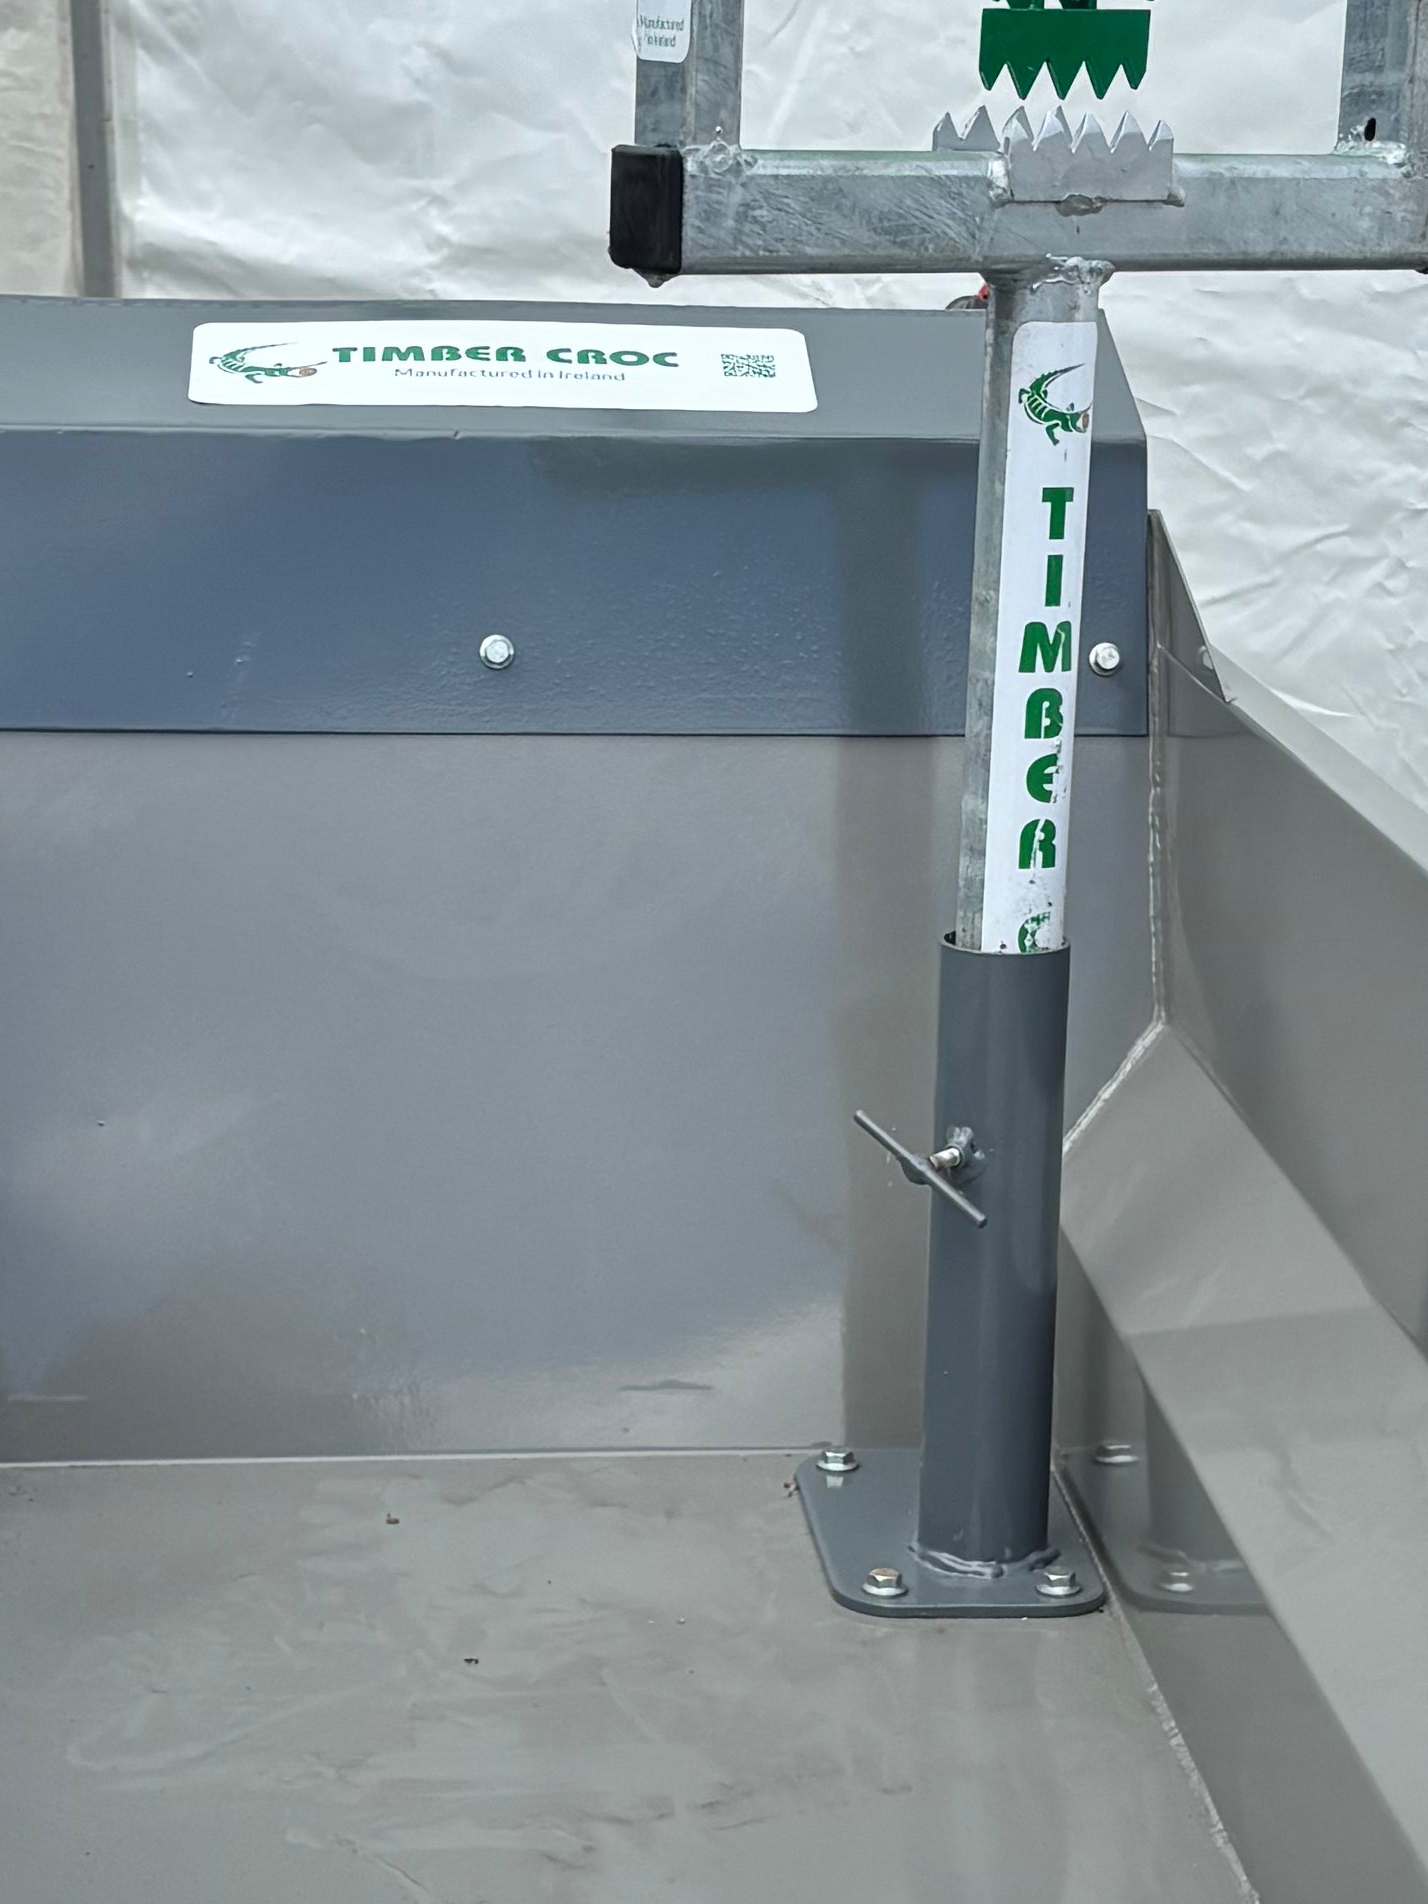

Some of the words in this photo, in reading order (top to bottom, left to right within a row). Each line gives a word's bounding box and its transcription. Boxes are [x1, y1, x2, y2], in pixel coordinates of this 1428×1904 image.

[331, 345, 526, 363] TIMBER
[546, 348, 679, 368] CROC
[394, 367, 532, 380] Manufactured
[537, 369, 554, 380] in
[558, 369, 626, 382] Ireland
[1018, 487, 1074, 869] TIMBER
